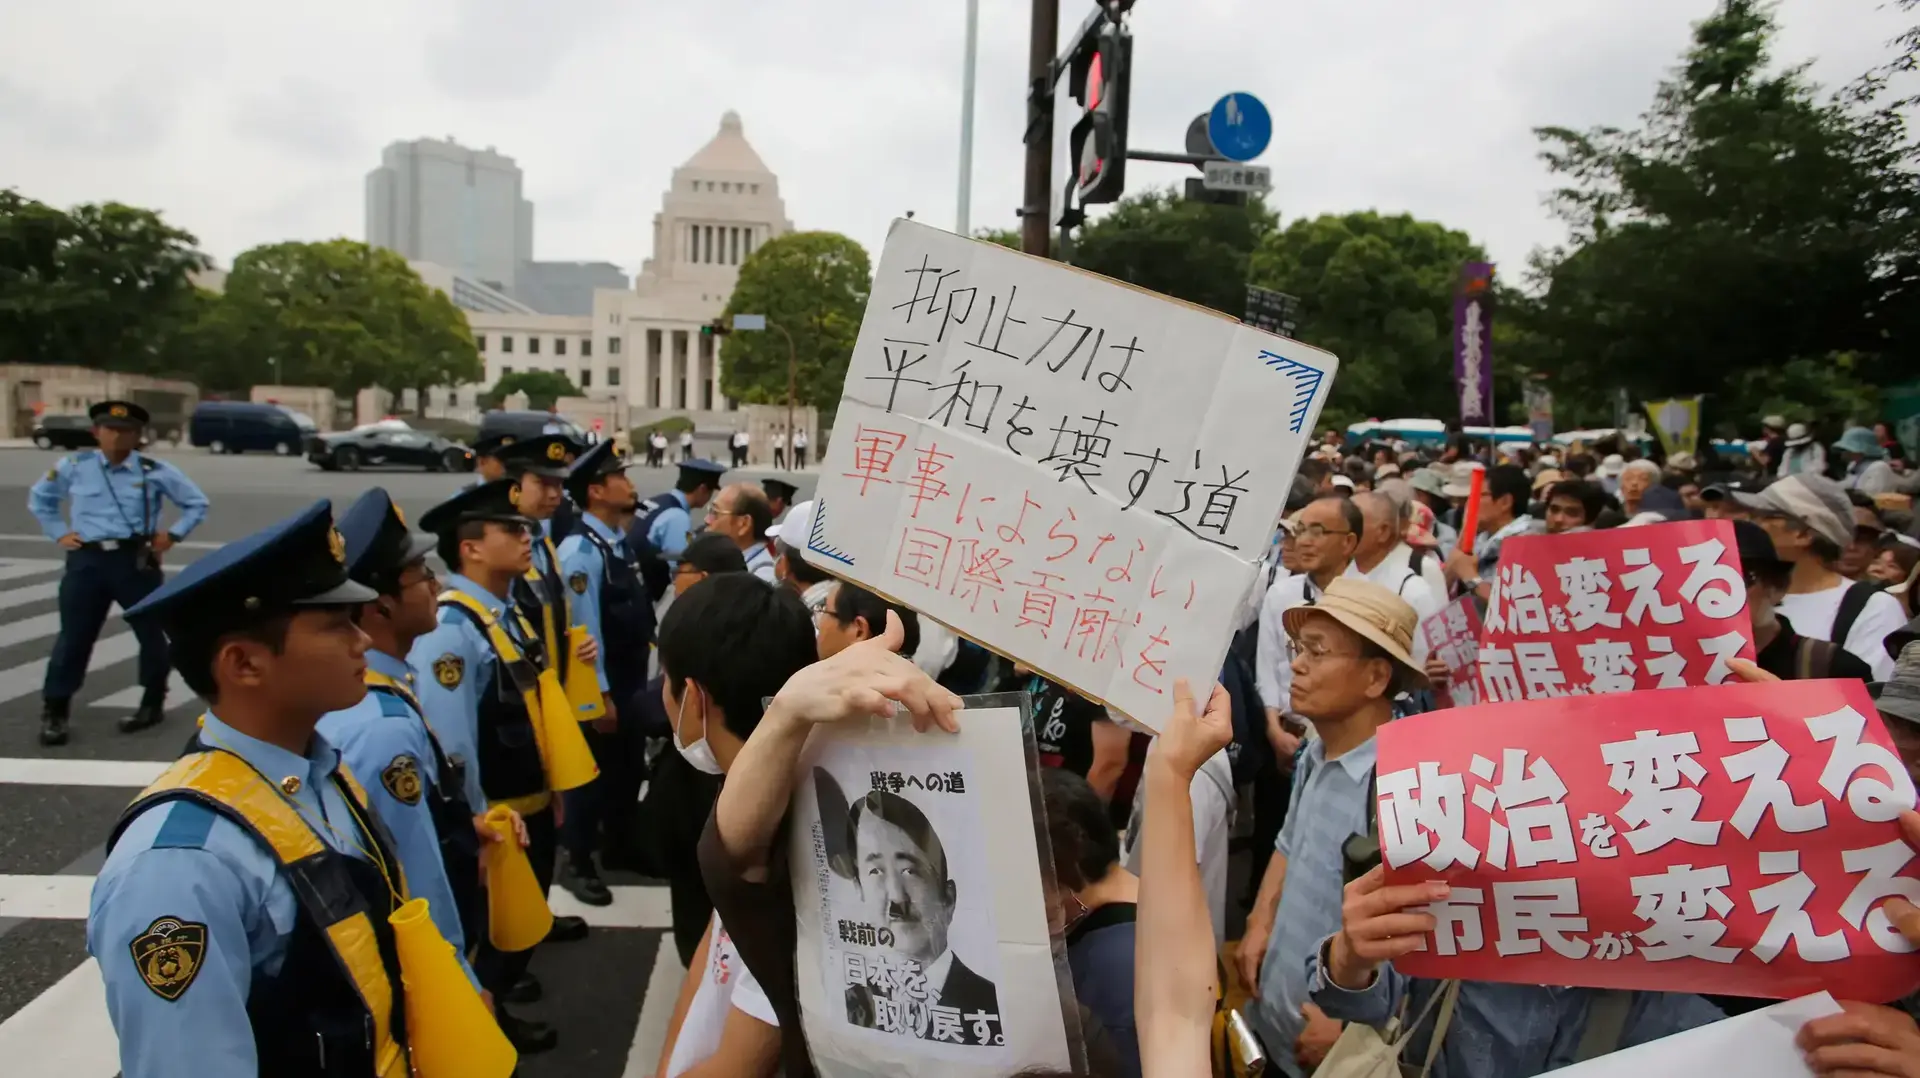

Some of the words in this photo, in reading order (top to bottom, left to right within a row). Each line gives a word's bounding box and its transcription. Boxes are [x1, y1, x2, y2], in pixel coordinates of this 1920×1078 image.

[893, 253, 1145, 392] 抑止力は
[842, 423, 1196, 610] 軍事によらない
[865, 338, 1250, 550] 平和を壊す道
[894, 528, 1172, 694] 国際貢献を
[870, 771, 965, 793] 戦争への道
[1377, 704, 1917, 872] 政治を変える
[838, 919, 895, 948] 戦前の
[872, 994, 1006, 1046] 取り戻す。
